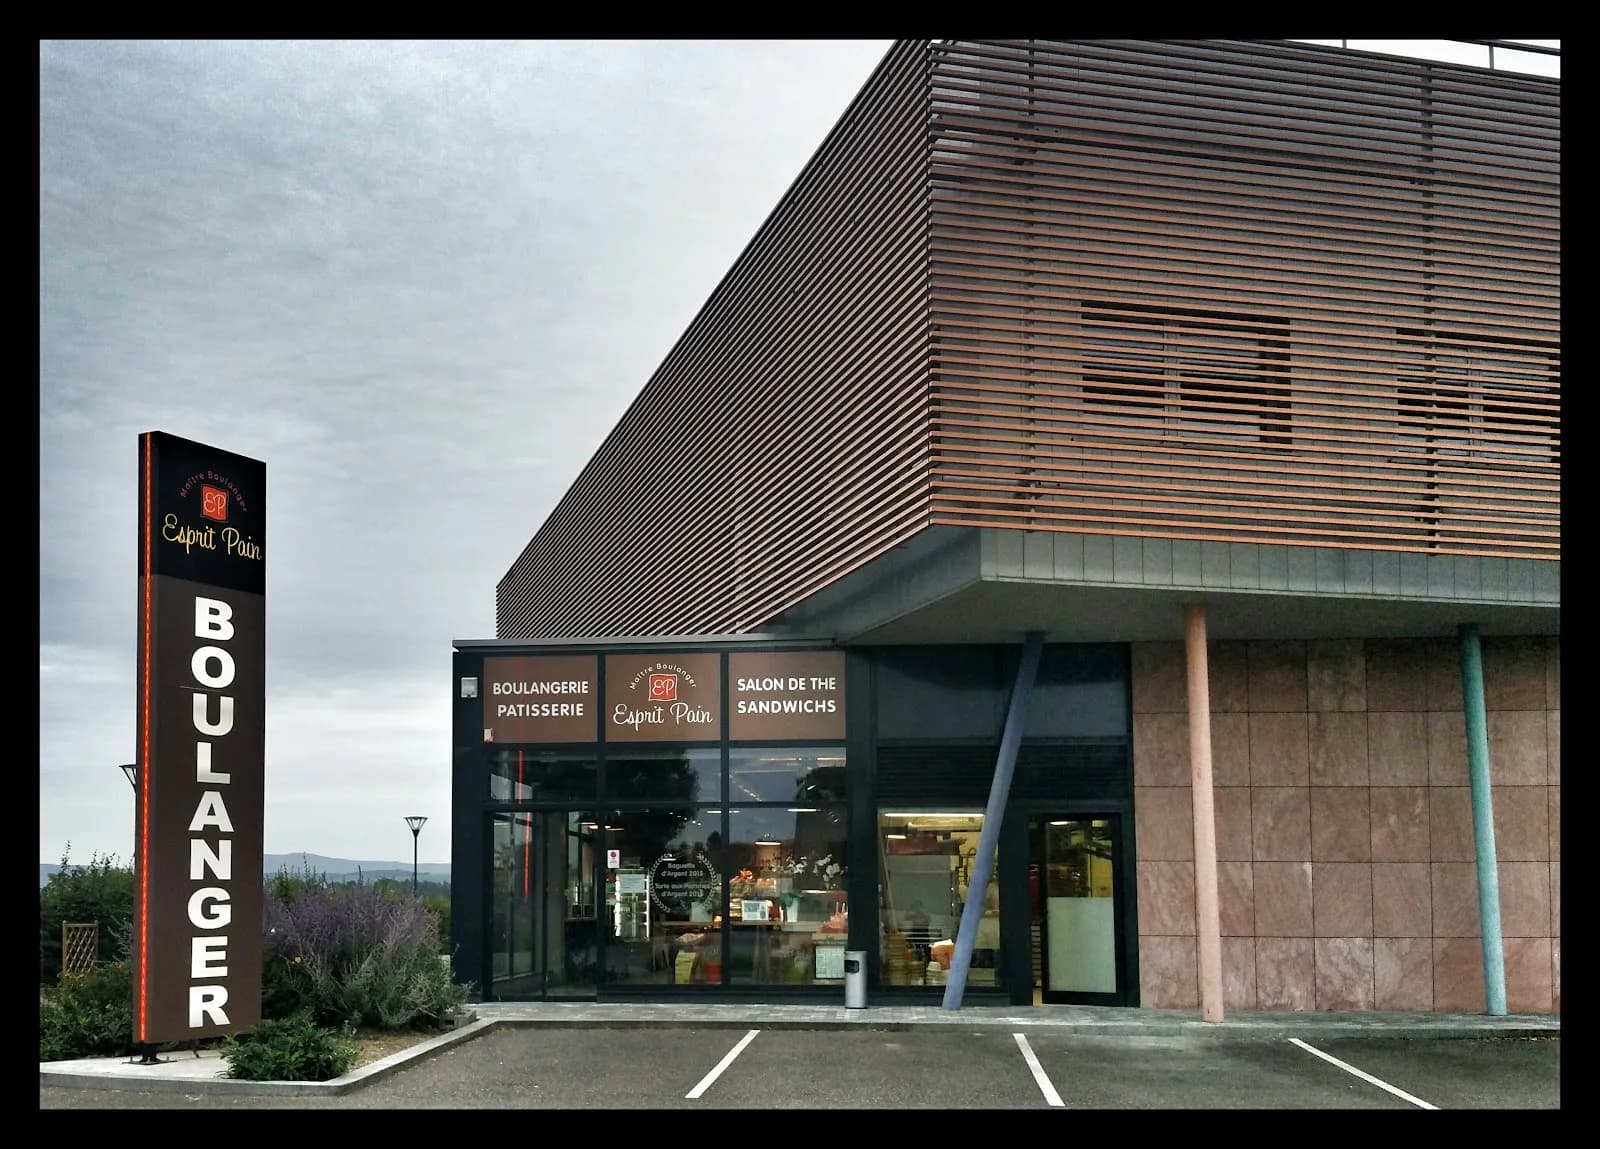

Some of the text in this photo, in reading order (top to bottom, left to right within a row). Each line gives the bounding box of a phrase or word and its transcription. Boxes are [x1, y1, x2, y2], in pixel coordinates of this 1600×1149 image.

[207, 470, 247, 512] Boulanger
[203, 492, 226, 515] EP
[162, 513, 263, 561] Esprit Pain
[652, 678, 675, 696] EP
[656, 662, 697, 689] Boulanger
[737, 677, 836, 692] SALON DE THE
[492, 680, 589, 696] BOULANGERIE
[497, 703, 584, 718] PATISSERIE
[612, 703, 713, 731] Esprit Pain
[737, 699, 836, 715] SANDWICHS
[187, 596, 236, 1028] BOULANGER
